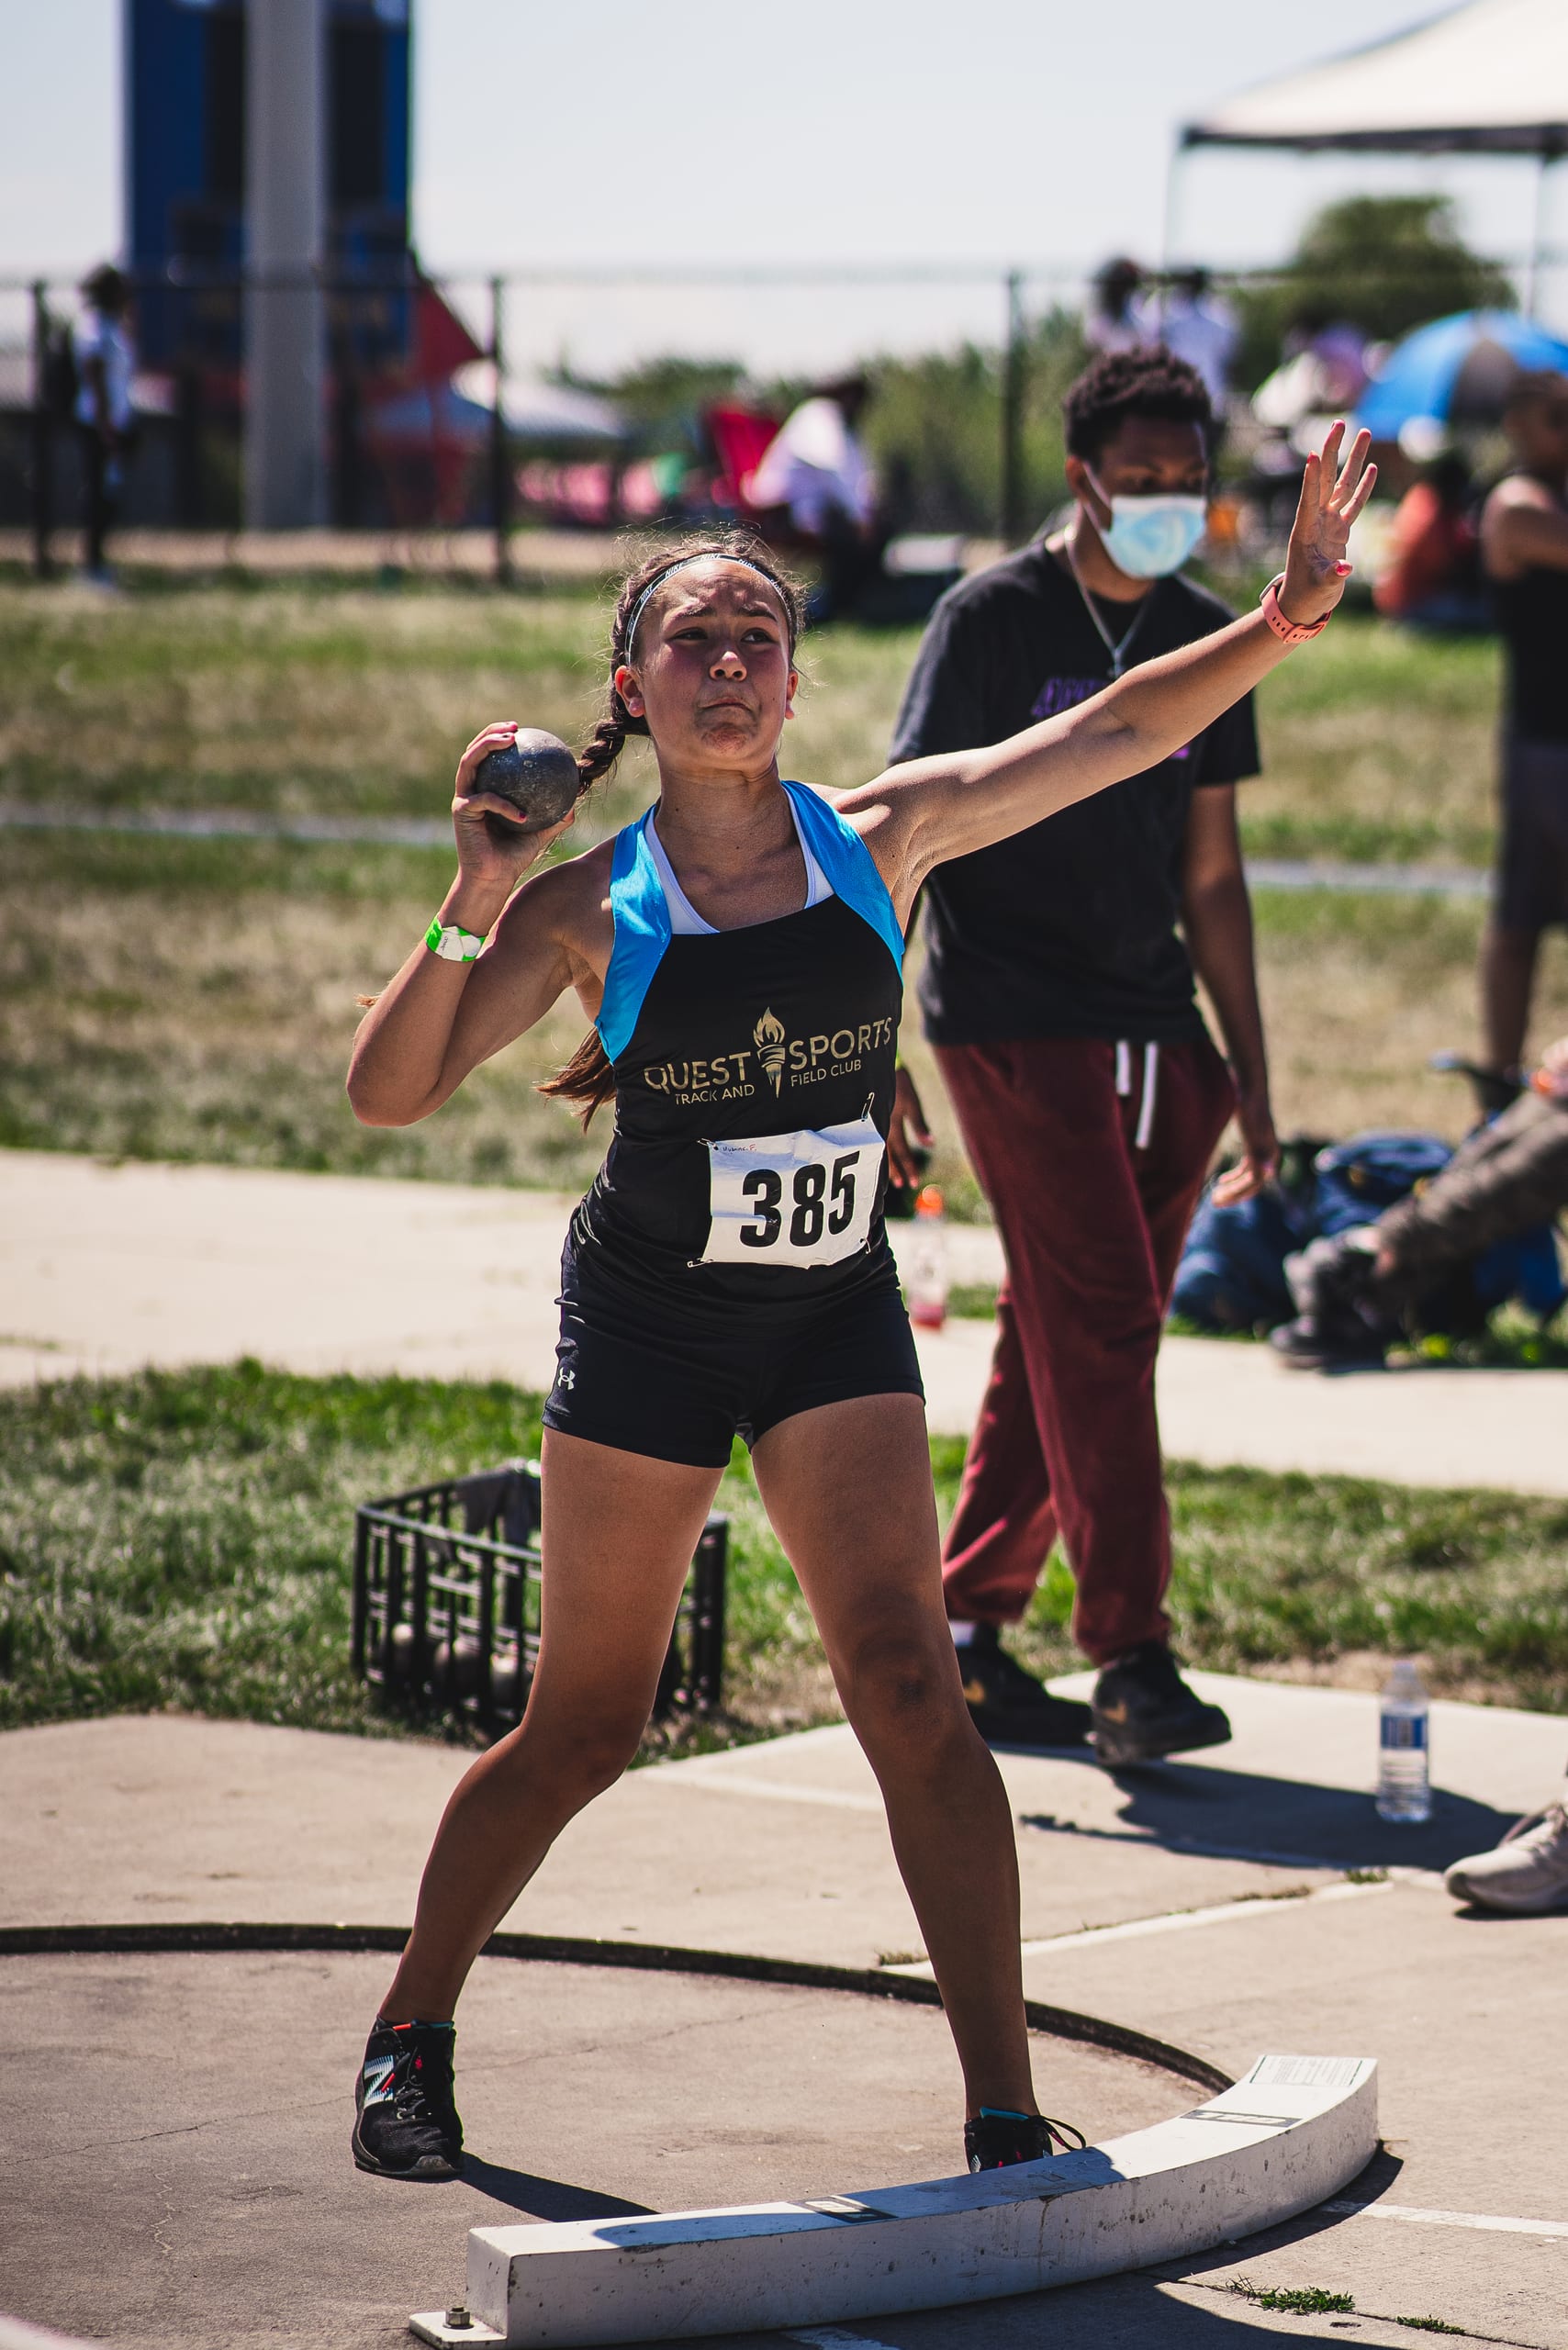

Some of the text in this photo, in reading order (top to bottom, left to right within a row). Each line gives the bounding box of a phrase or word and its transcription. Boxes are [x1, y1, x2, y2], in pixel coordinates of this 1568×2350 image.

[666, 563, 682, 577] NIKE
[644, 1017, 891, 1094] QUEST SPORTS
[675, 1059, 861, 1105] TRACK AND FIELD CLUB
[739, 1150, 860, 1248] 385
